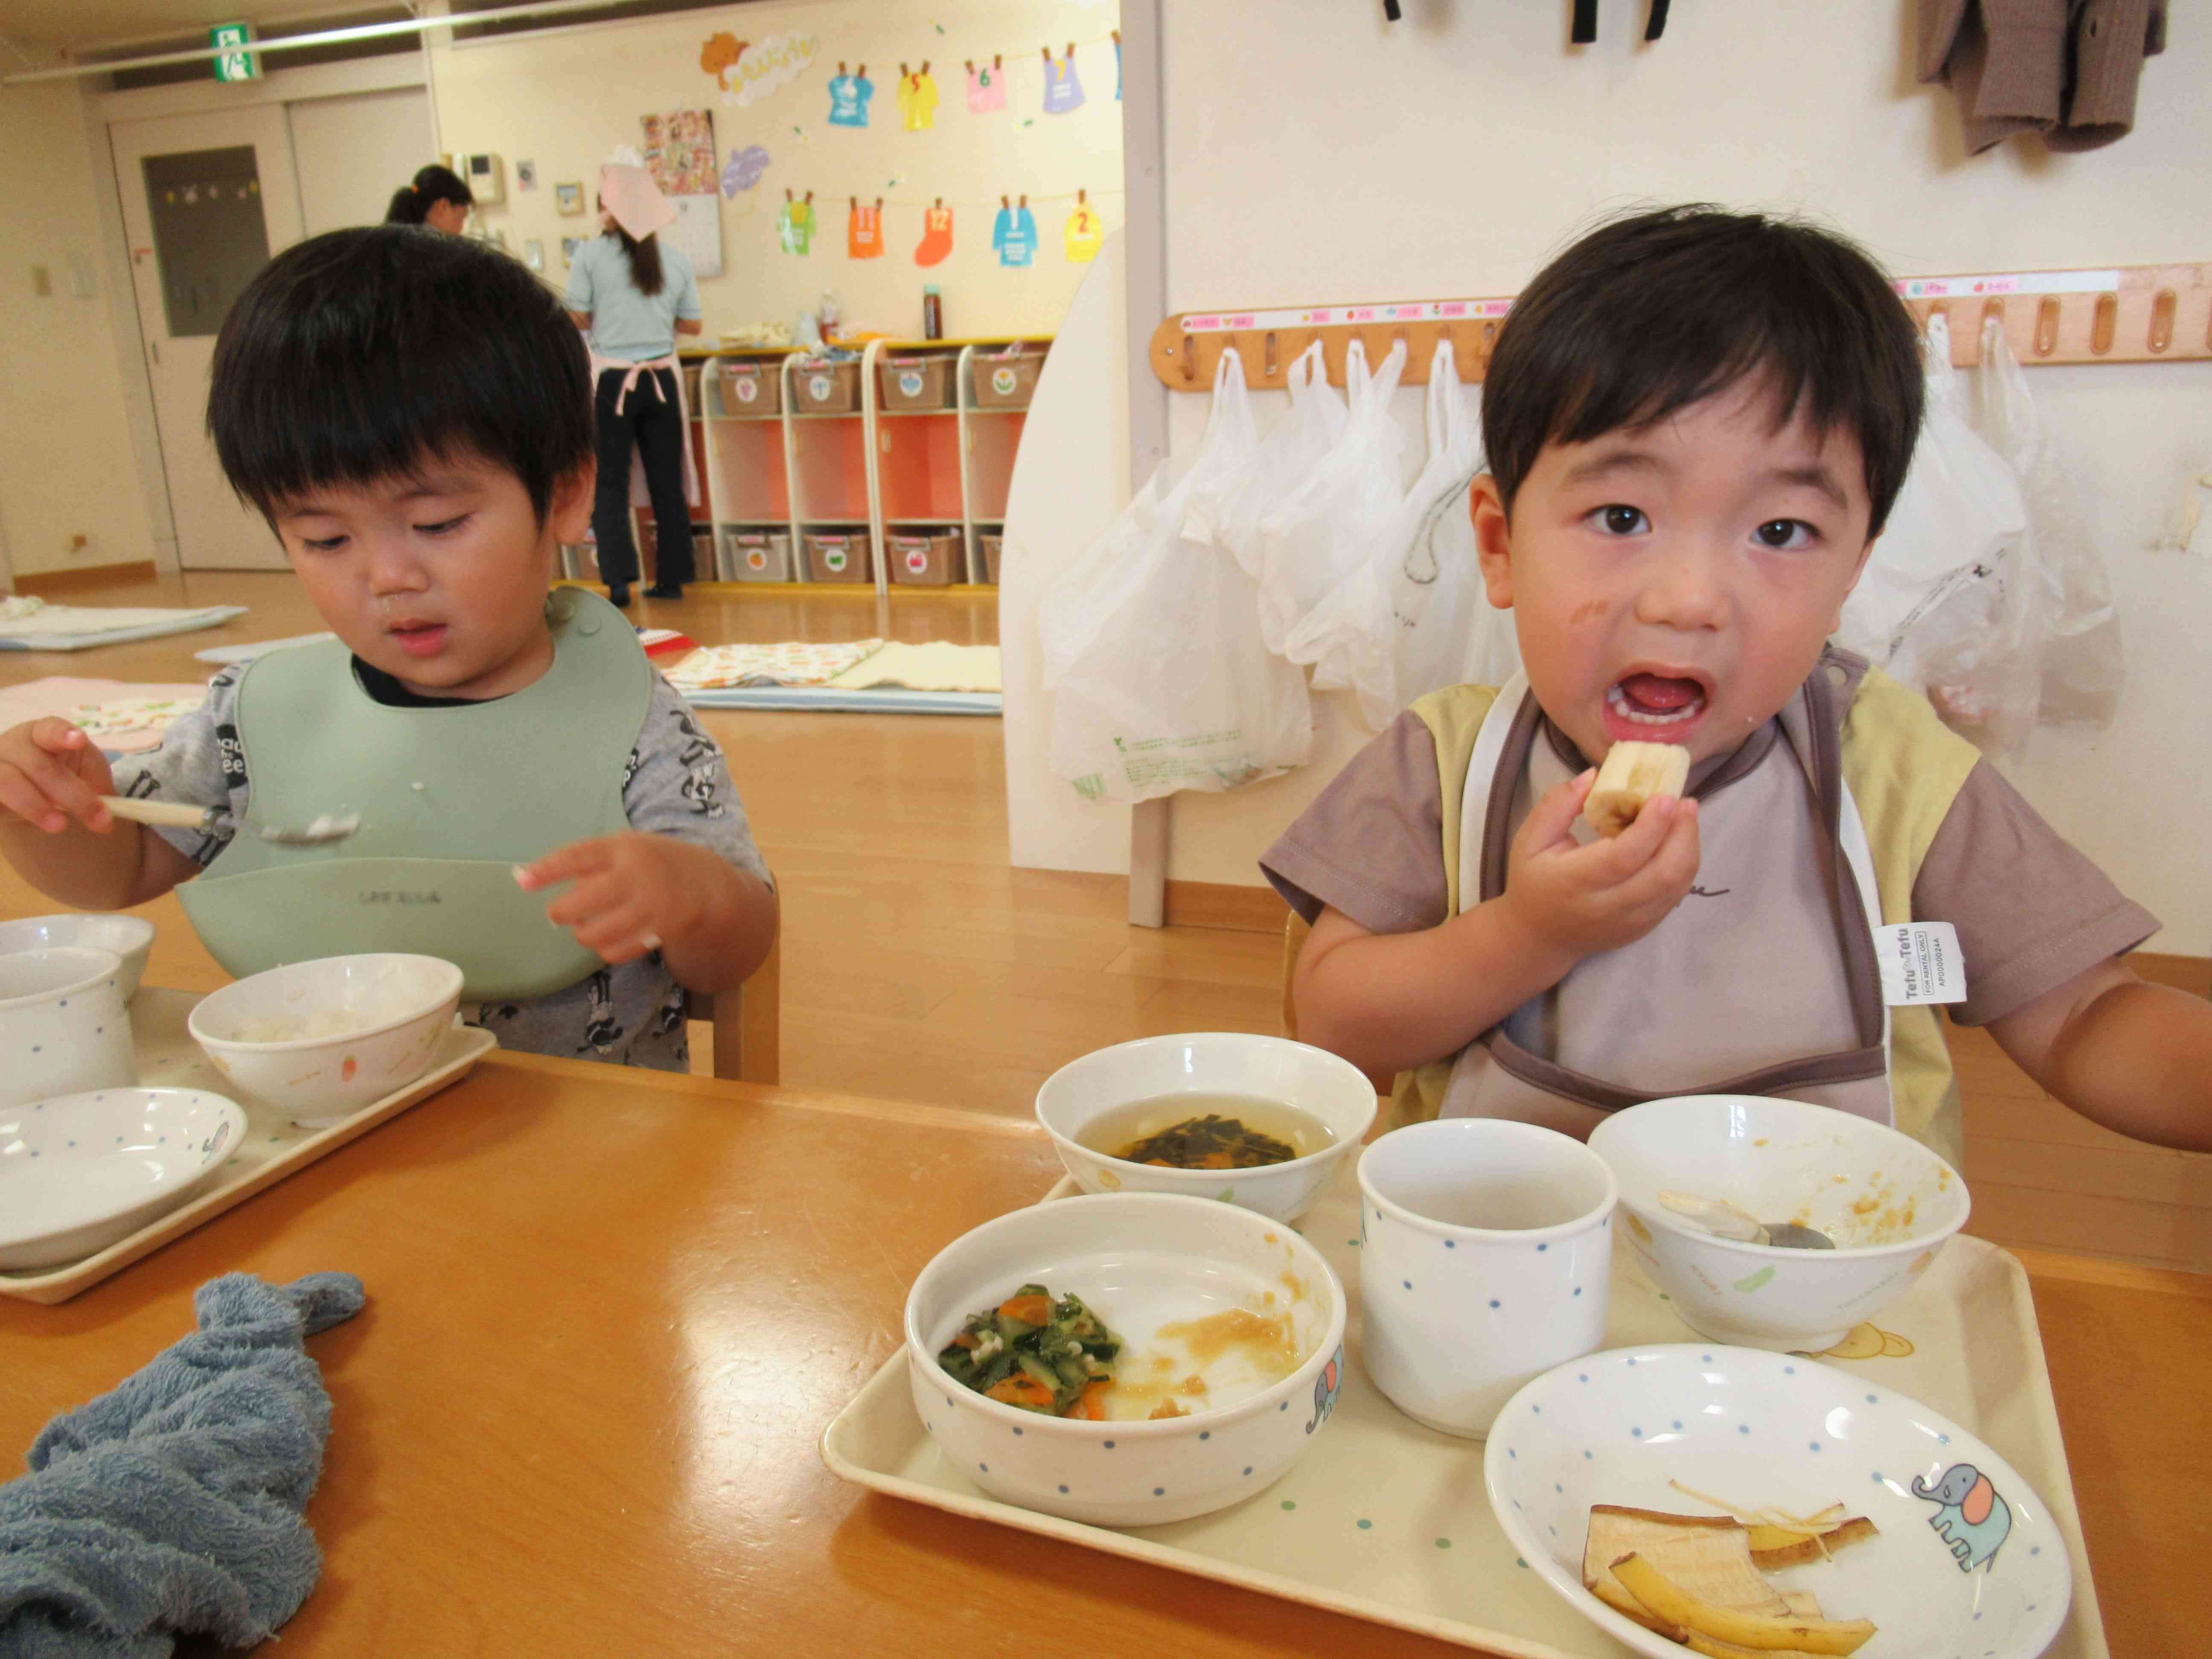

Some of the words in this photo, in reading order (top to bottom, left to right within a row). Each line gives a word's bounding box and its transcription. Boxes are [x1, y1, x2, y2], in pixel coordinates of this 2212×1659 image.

[979, 68, 990, 87] 6
[1054, 59, 1066, 81] 7
[911, 73, 920, 93] 5
[858, 208, 875, 228] 11
[932, 210, 949, 231] 12
[1010, 207, 1019, 230] 1
[1078, 212, 1088, 233] 2
[1897, 928, 1912, 958] Tefu
[1918, 934, 1926, 952] ONLY
[1921, 953, 1929, 978] RENTAL
[1905, 970, 1918, 1000] Tefu
